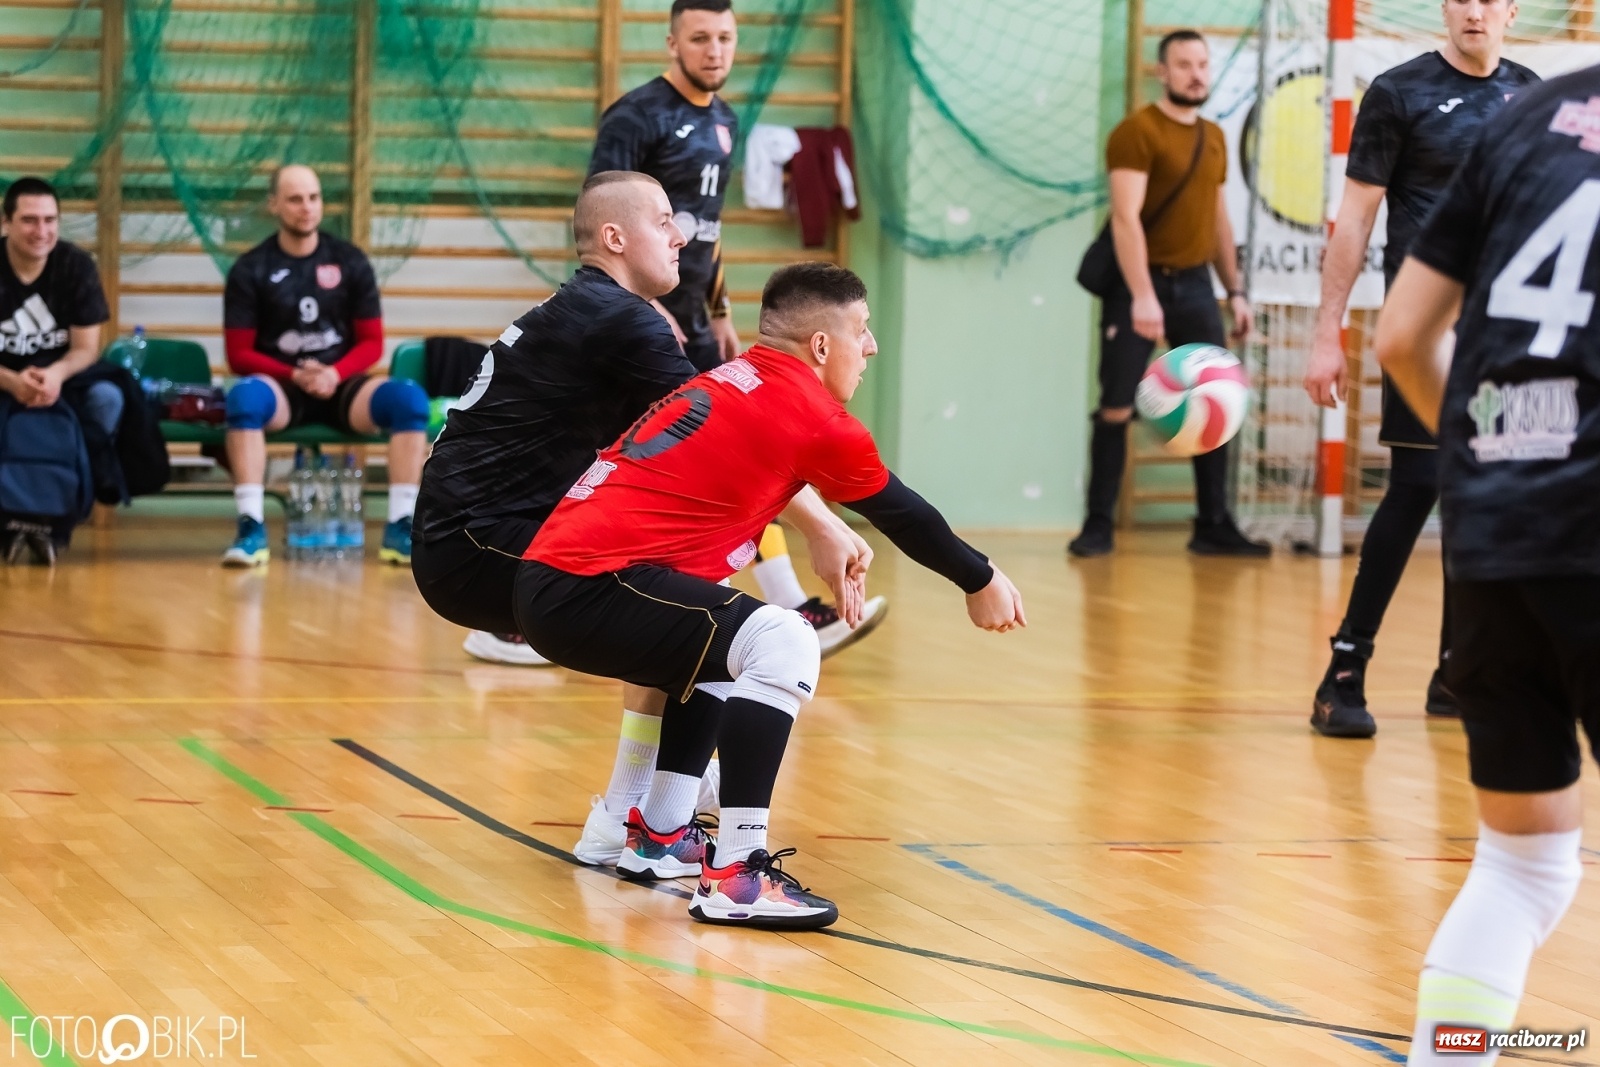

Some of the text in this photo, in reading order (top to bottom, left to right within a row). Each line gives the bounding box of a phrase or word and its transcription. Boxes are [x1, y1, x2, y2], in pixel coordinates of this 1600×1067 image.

[700, 163, 720, 197] 11
[1486, 178, 1600, 359] 4
[299, 295, 320, 324] 9
